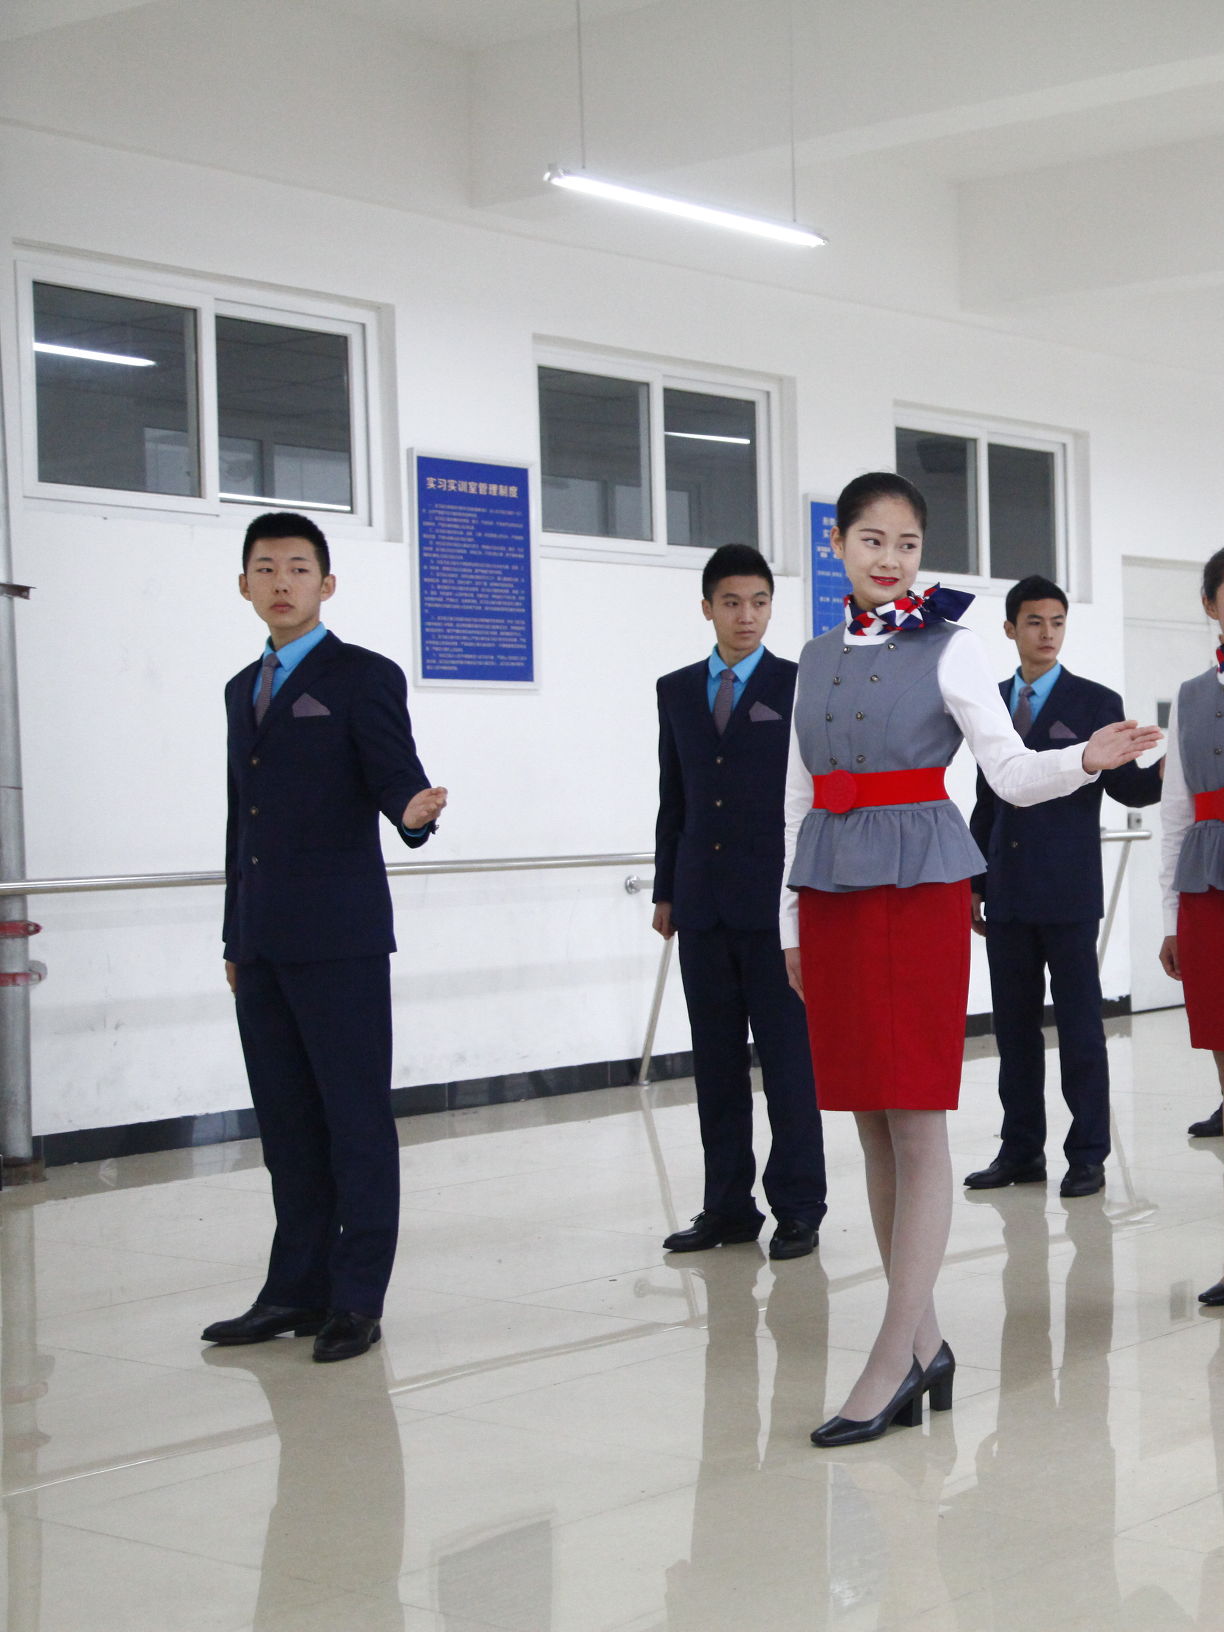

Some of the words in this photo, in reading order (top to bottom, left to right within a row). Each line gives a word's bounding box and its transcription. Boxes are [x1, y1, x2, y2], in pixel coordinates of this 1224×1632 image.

[426, 477, 519, 498] 实习实训室管理制度
